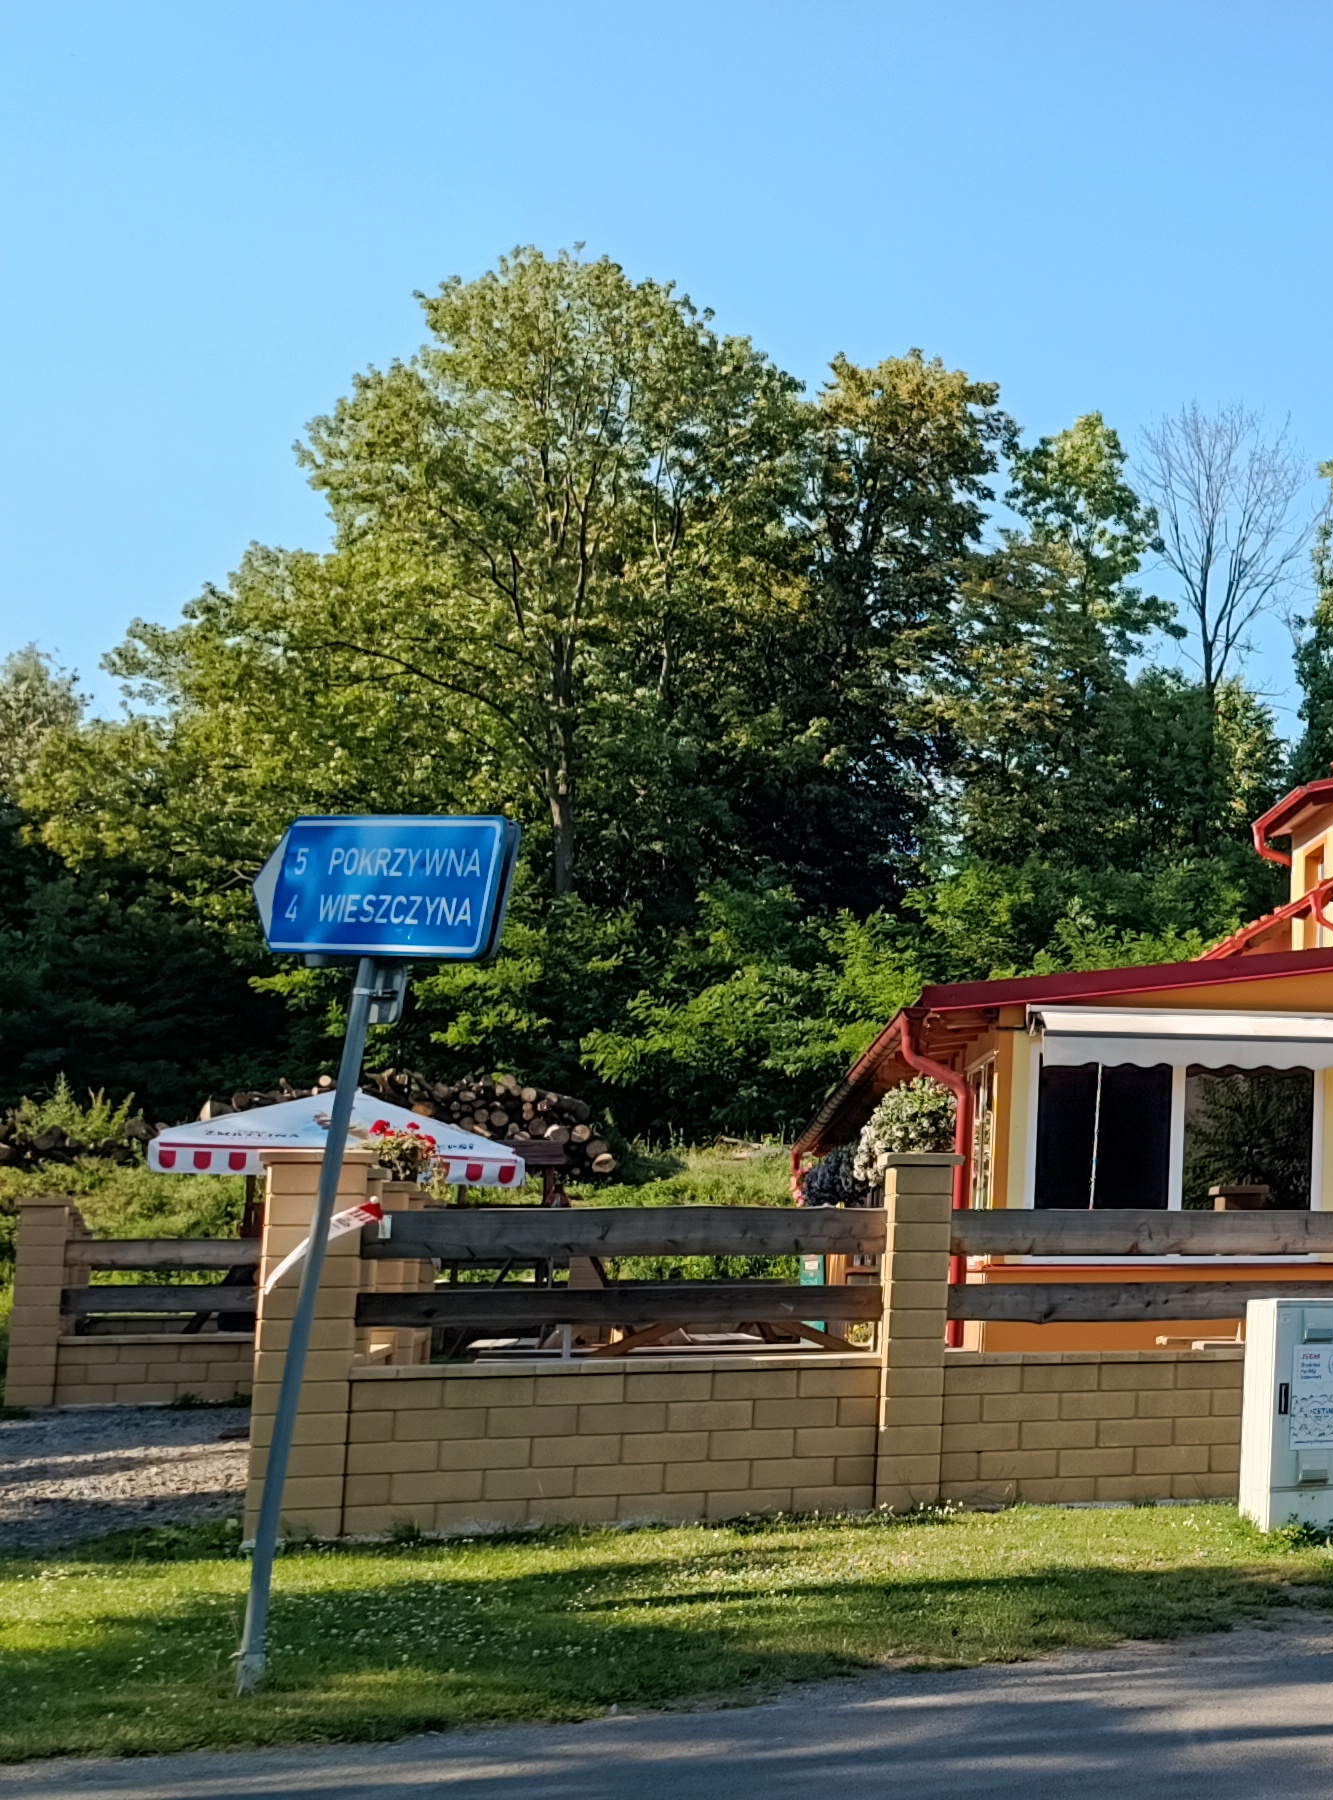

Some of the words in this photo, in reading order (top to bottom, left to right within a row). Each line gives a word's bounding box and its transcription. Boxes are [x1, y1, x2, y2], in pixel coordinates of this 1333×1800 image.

[294, 848, 309, 876] 5
[328, 848, 481, 877] POKRZYWNA
[285, 894, 298, 922] 4
[319, 894, 472, 927] WIESZCZYNA
